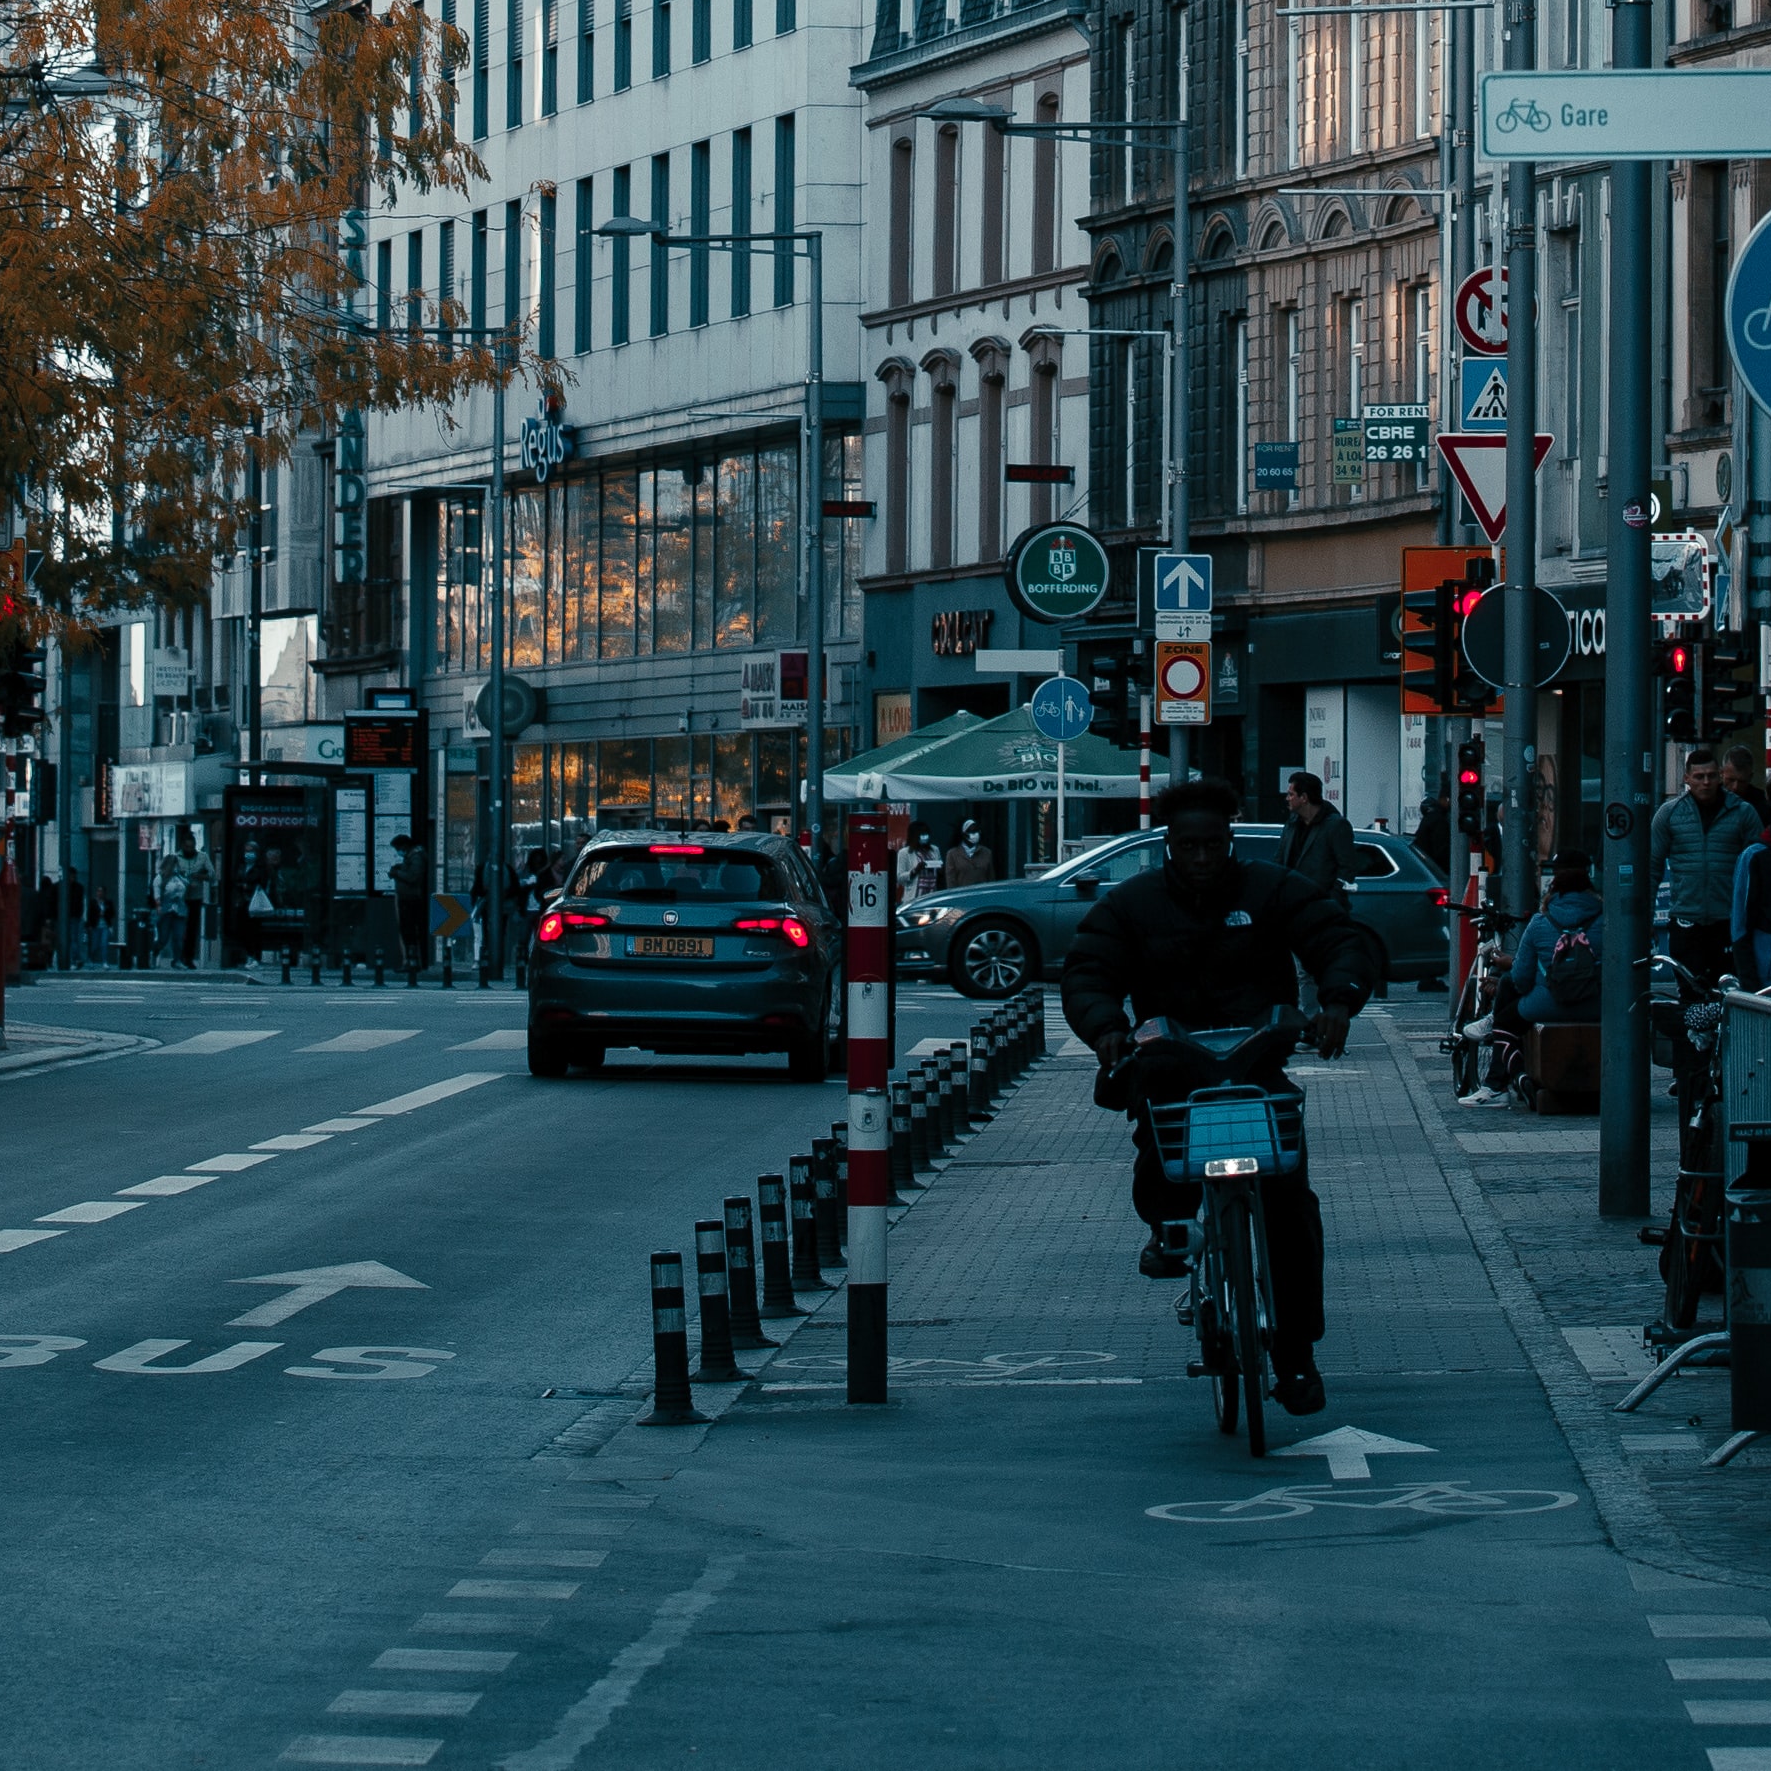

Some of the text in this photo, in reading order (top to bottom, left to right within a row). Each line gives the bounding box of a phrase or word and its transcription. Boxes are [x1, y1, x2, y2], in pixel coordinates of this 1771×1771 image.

[1560, 103, 1609, 128] Gare
[342, 209, 365, 584] SAANDER
[1370, 408, 1394, 416] FOR
[1366, 426, 1415, 439] CBRE
[520, 417, 566, 483] Regus
[1367, 446, 1388, 459] 26
[1392, 446, 1413, 459] 26
[1257, 468, 1294, 476] 20 60 65
[1335, 466, 1347, 476] 34
[1028, 583, 1098, 593] BOFFERDING
[1163, 646, 1204, 654] ZONE
[983, 780, 1004, 792] De
[1008, 777, 1038, 791] BIO
[1074, 779, 1104, 792] hei.
[858, 884, 877, 908] 16
[667, 939, 704, 953] 0891
